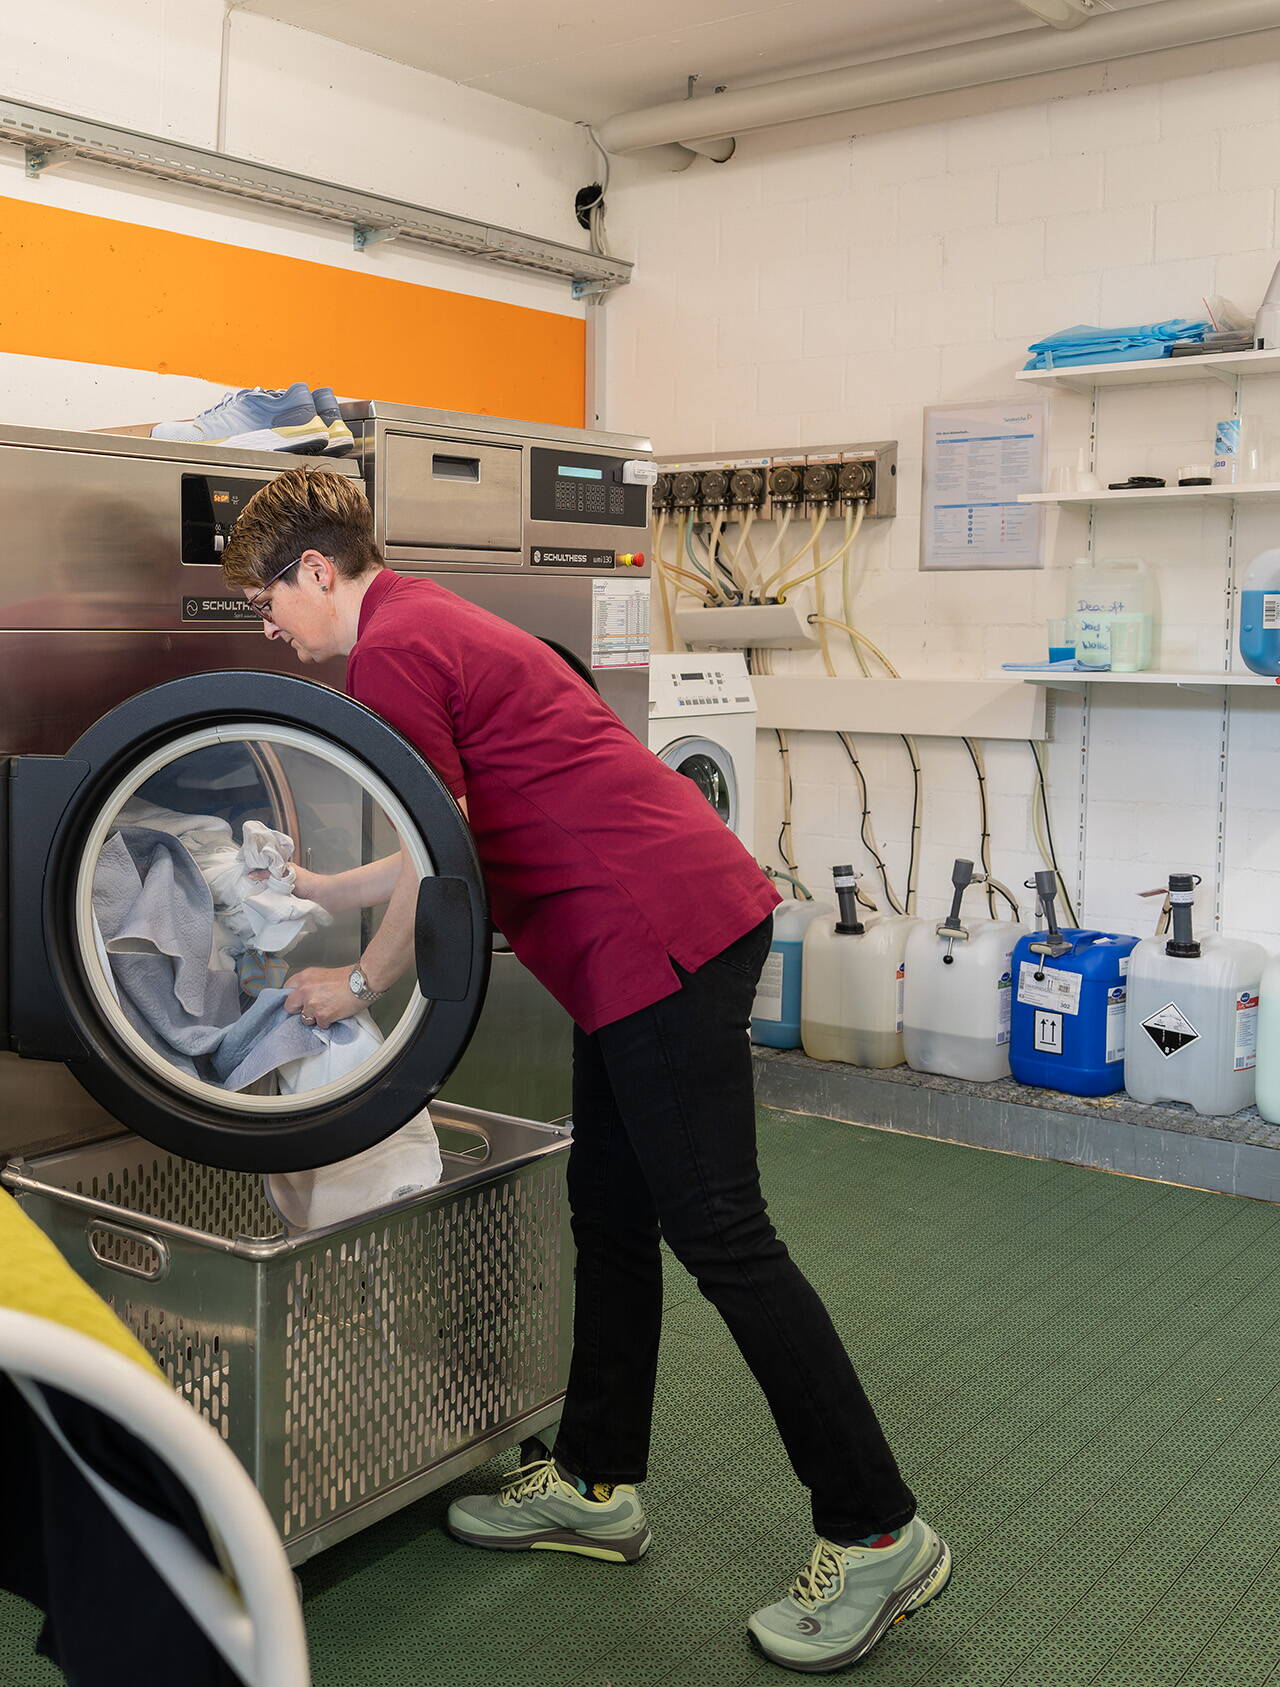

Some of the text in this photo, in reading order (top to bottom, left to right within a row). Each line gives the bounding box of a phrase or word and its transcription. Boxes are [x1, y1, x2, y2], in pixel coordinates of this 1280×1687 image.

[543, 553, 587, 563] SCHULTHESS
[202, 601, 253, 611] SCHULTH
[1060, 1002, 1071, 1010] 302
